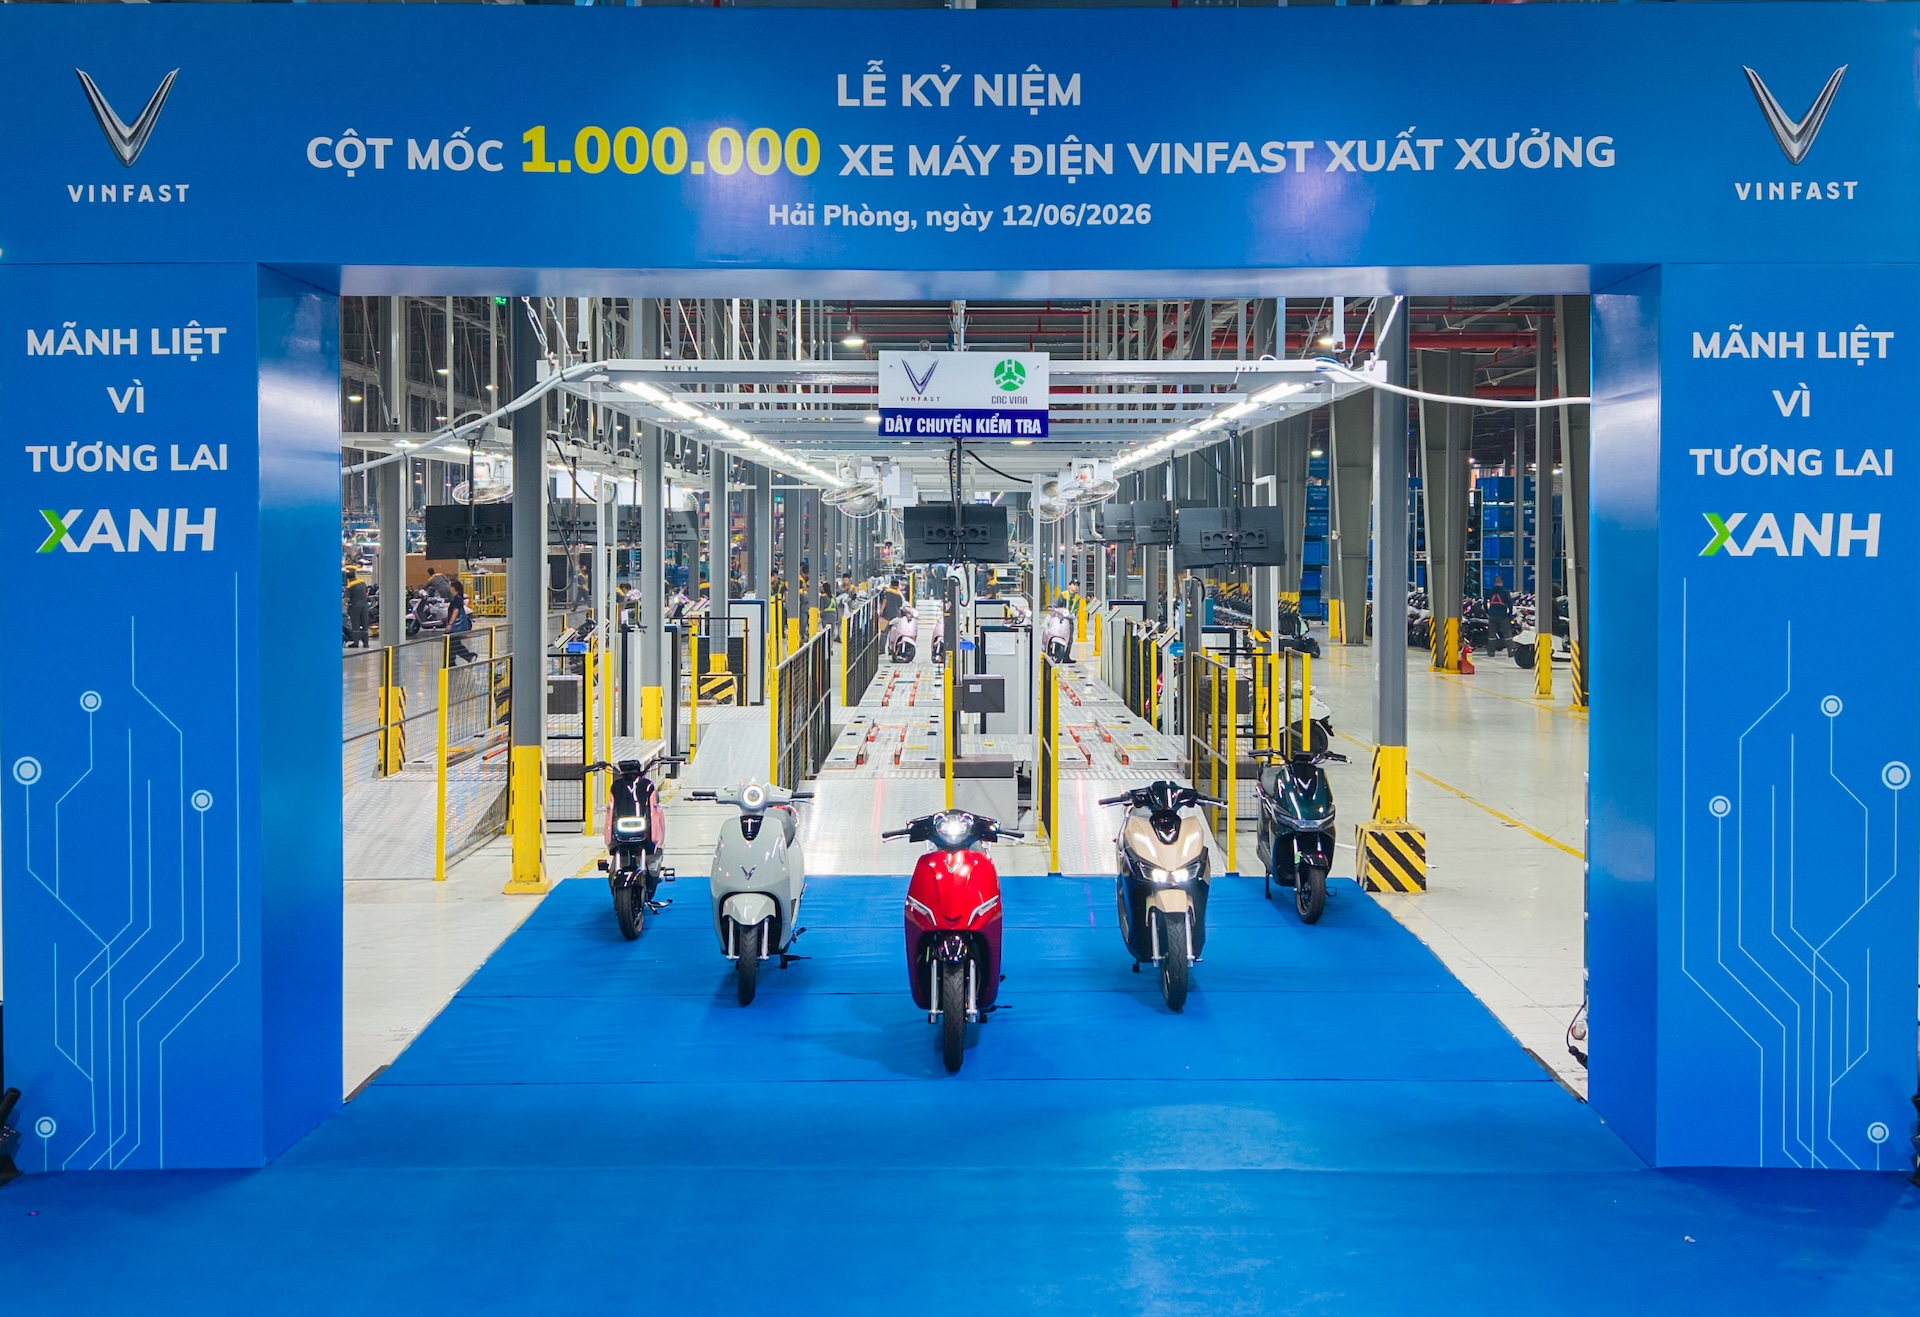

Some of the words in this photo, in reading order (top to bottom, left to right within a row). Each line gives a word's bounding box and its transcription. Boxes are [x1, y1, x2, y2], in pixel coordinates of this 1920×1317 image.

[837, 59, 887, 107] LỄ
[902, 64, 962, 107] KỶ
[974, 63, 1081, 116] NIỆM
[306, 128, 394, 178] CỘT
[407, 126, 504, 172] MỐC
[522, 125, 822, 176] 1.000.000
[839, 144, 894, 176] XE
[908, 135, 1001, 176] MÁY
[1010, 134, 1114, 184] ĐIỆN
[1127, 140, 1318, 173] VINFAST
[1323, 126, 1444, 171] XUẤT
[1454, 127, 1615, 170] XƯỞNG
[67, 184, 190, 203] VINFAST
[1734, 181, 1858, 201] VINFAST
[768, 202, 815, 226] Hải
[823, 203, 917, 233] Phòng,
[926, 203, 994, 233] ngày
[1002, 203, 1152, 228] 12/06/2026
[27, 321, 138, 356] MÃNH
[151, 319, 227, 362] LIỆT
[1692, 323, 1805, 359] MÃNH
[1817, 323, 1895, 366] LIỆT
[106, 378, 145, 414] VÌ
[1772, 382, 1811, 417] VÌ
[885, 414, 913, 432] DÂY
[976, 412, 1011, 433] KIỂM
[1015, 419, 1041, 434] TRA
[25, 440, 158, 473] TƯƠNG
[170, 443, 228, 471] LAI
[1689, 444, 1823, 477] TƯƠNG
[1835, 448, 1893, 476] LAI
[36, 507, 217, 553] XANH
[1698, 512, 1882, 558] XANH
